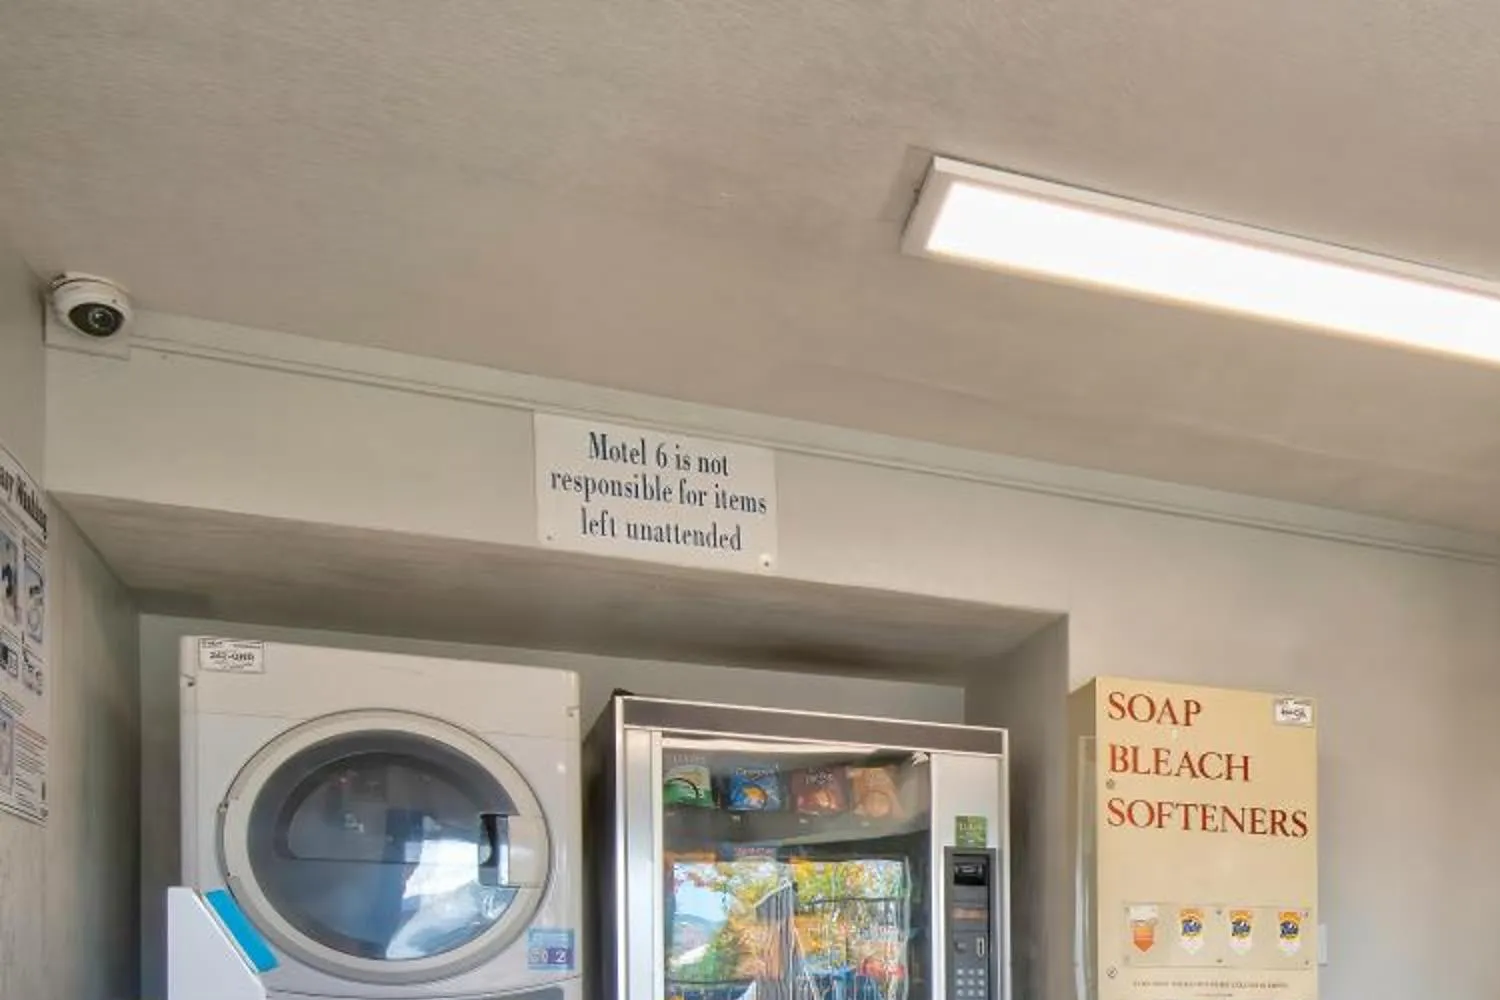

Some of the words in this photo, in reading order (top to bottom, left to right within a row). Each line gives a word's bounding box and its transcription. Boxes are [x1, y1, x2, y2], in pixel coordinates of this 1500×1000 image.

[589, 431, 646, 466] Motel
[655, 442, 668, 469] 6
[674, 444, 691, 471] is
[697, 453, 729, 477] not
[550, 470, 673, 504] responsible
[678, 478, 707, 507] for
[714, 483, 768, 514] items
[580, 507, 617, 538] left
[626, 520, 742, 552] unattended
[1107, 691, 1202, 727] SOAP
[1108, 743, 1251, 783] BLEACH
[1106, 797, 1309, 839] SOFTENERS
